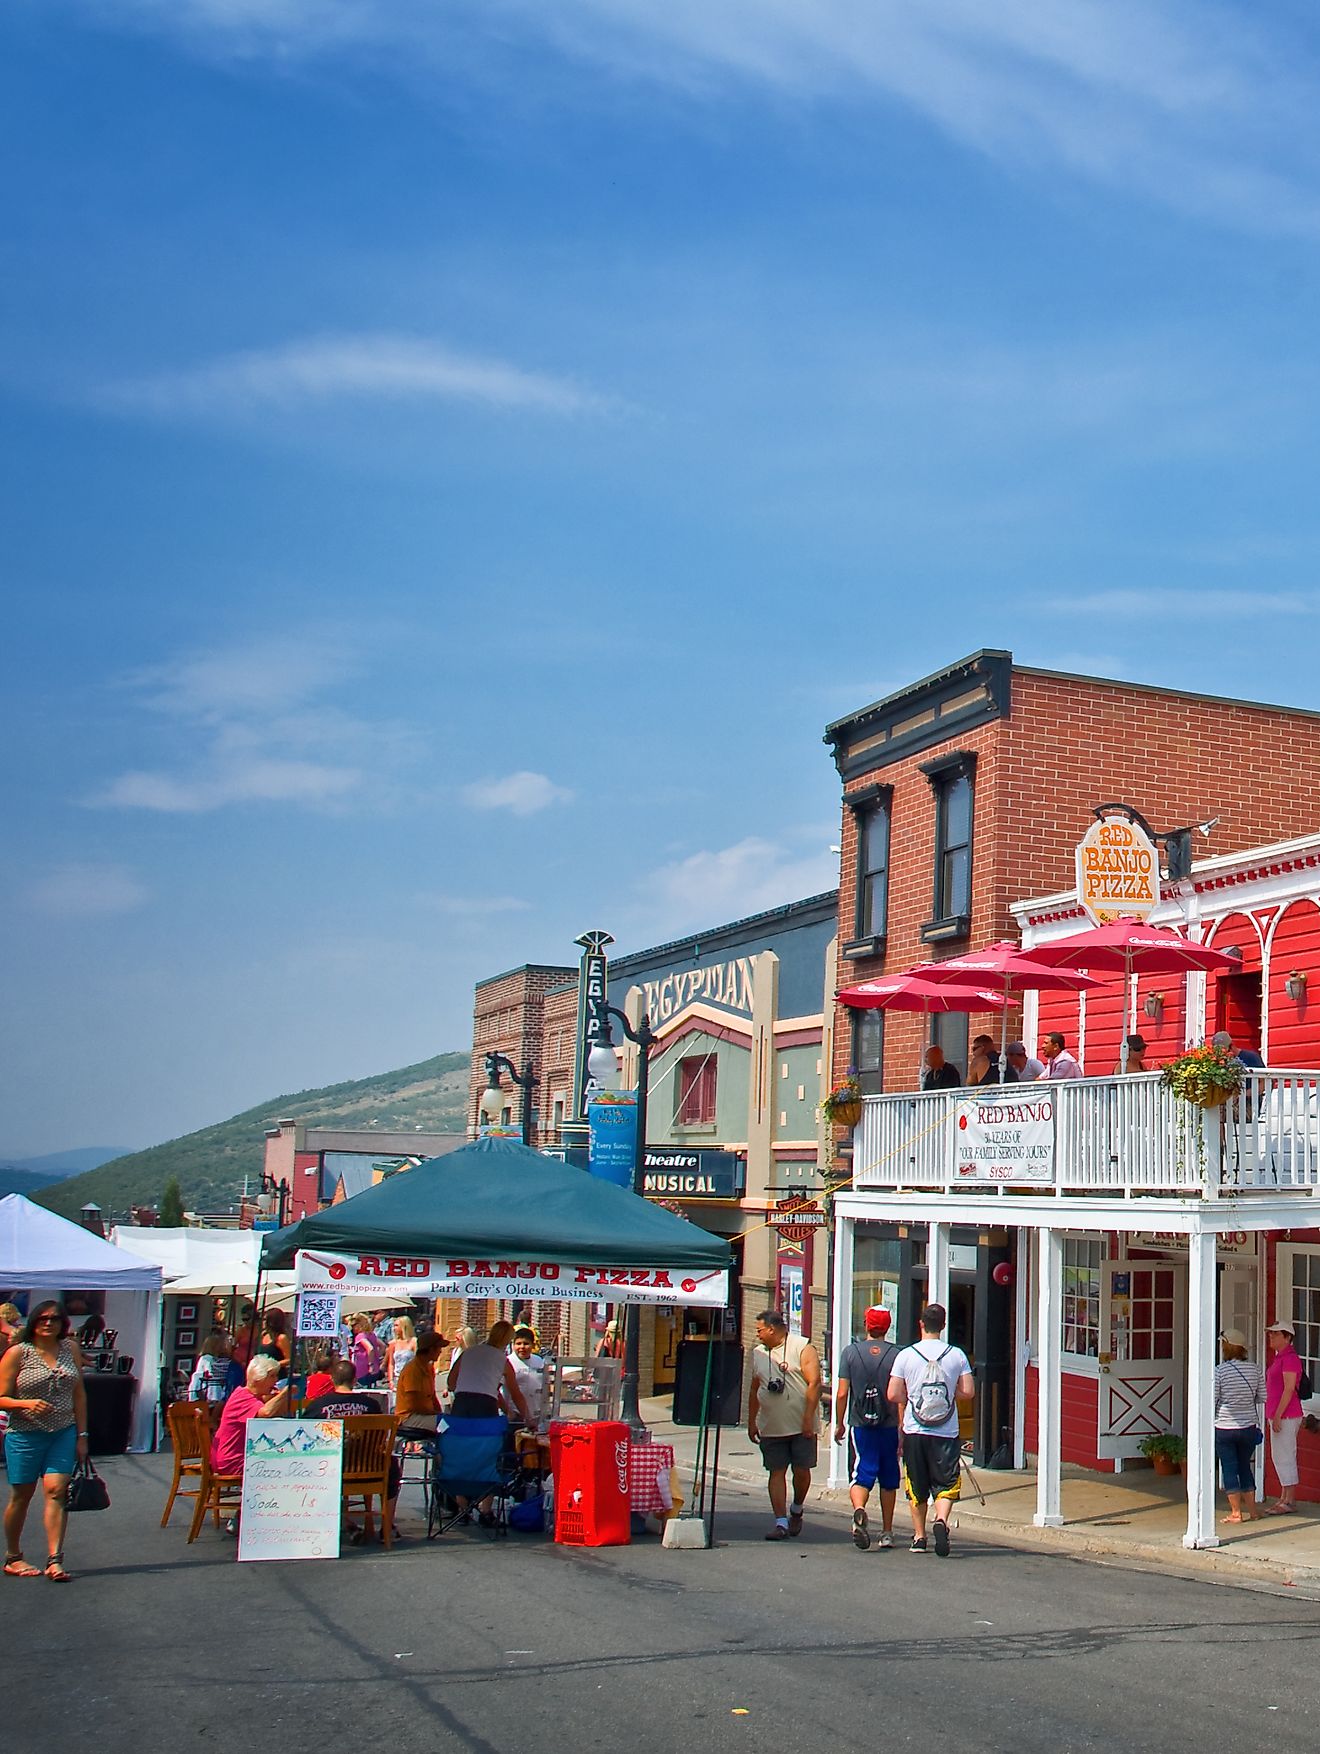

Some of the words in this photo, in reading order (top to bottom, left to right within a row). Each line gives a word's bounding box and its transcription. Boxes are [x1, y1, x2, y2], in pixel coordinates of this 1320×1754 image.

[1099, 825, 1133, 846] RED
[1085, 847, 1152, 874] BANJO
[1087, 874, 1153, 899] PIZZA
[644, 954, 757, 1026] EGYPTIAN
[977, 1104, 1004, 1124] RED
[1006, 1102, 1052, 1122] BANJO
[974, 1145, 998, 1160] FAMILY
[999, 1145, 1025, 1160] SERVING
[989, 1166, 1014, 1178] SYSCO
[643, 1174, 717, 1193] MUSICAL
[357, 1256, 431, 1278] RED
[446, 1259, 560, 1280] BANJO
[574, 1266, 673, 1288] PIZZA
[430, 1282, 460, 1294] Park
[464, 1283, 501, 1298] City's
[506, 1284, 546, 1298] Oldest
[551, 1286, 604, 1299] Business
[626, 1293, 652, 1302] EST.
[656, 1294, 678, 1303] 1962
